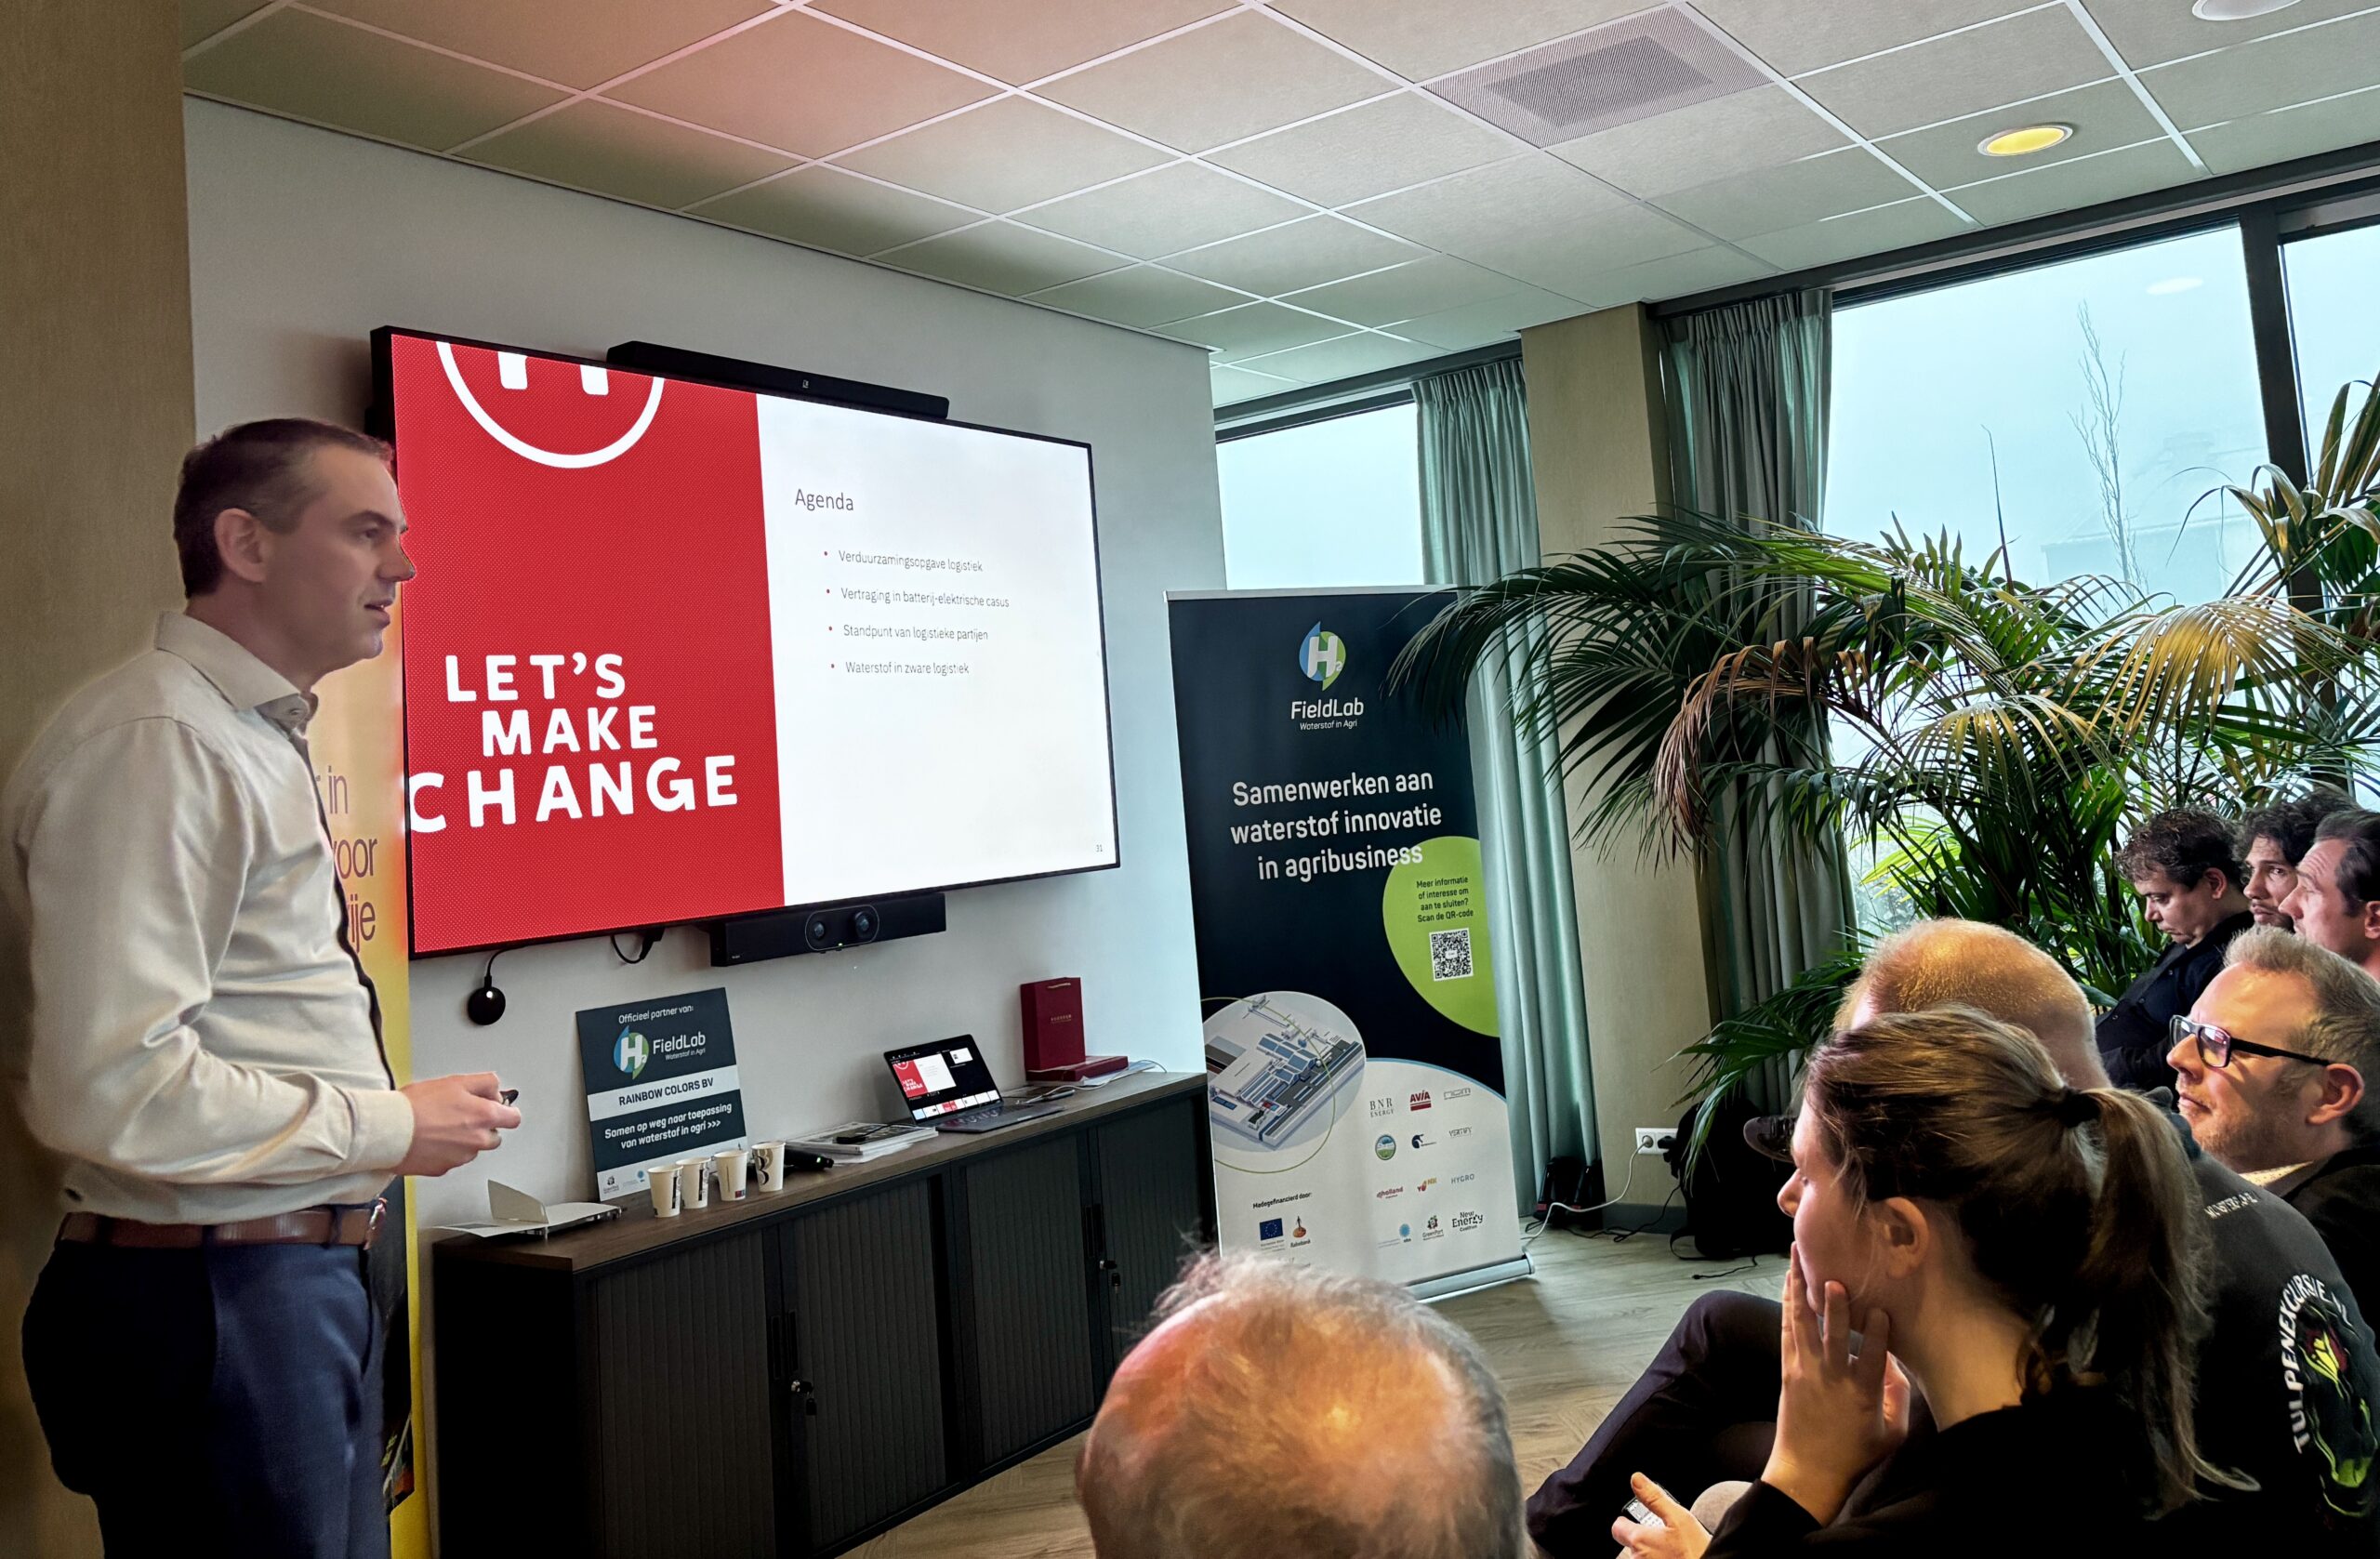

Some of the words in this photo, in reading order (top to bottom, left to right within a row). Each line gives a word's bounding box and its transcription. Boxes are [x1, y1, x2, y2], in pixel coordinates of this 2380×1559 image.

[795, 488, 853, 511] Agenda
[839, 549, 945, 571] Verduurzamingsopgave
[947, 559, 983, 573] logistiek
[840, 587, 891, 604] Vertraging
[892, 590, 901, 602] in
[903, 591, 985, 606] batterij-elektrische
[985, 598, 1010, 608] casus
[843, 624, 892, 640] Standpunt
[894, 628, 910, 638] van
[913, 627, 955, 641] logistieke
[957, 628, 988, 642] partijen
[445, 652, 626, 702] LET'S
[845, 661, 892, 674] Waterstof
[893, 662, 903, 673] in
[905, 664, 932, 674] zware
[933, 662, 970, 677] logistiek
[1290, 697, 1364, 720] FieldLab
[482, 705, 657, 757] MAKE
[1300, 720, 1335, 731] Waterstof
[1336, 720, 1342, 729] in
[1343, 720, 1357, 730] Agri
[328, 765, 348, 814] in
[409, 755, 737, 833] CHANGE
[1233, 772, 1389, 807] Samenwerken
[1395, 772, 1434, 793] aan
[1230, 811, 1340, 844] waterstof
[1344, 803, 1442, 834] innovatie
[1258, 855, 1278, 880] in
[1285, 845, 1423, 882] agribusiness
[1416, 880, 1434, 889] Meer
[1435, 876, 1468, 887] informatie
[1421, 903, 1433, 911] aan
[1443, 897, 1469, 908] sluiten?
[1426, 890, 1458, 899] interesse
[1417, 914, 1435, 922] Scan
[1446, 909, 1474, 920] QR-code
[618, 1011, 649, 1024] Officieel
[651, 1007, 678, 1021] partner
[679, 1005, 694, 1014] van:
[653, 1031, 706, 1054] FieldLab
[665, 1050, 690, 1061] Waterstof
[695, 1048, 706, 1057] Agri
[619, 1087, 663, 1106] RAINBOW
[664, 1080, 700, 1098] COLORS
[702, 1077, 714, 1090] BV
[1369, 1097, 1393, 1111] BNR
[604, 1124, 635, 1140] Samen
[637, 1123, 648, 1134] op
[649, 1117, 667, 1129] weg
[668, 1113, 687, 1125] naar
[687, 1102, 733, 1121] toepassing
[620, 1138, 637, 1150] van
[638, 1128, 681, 1146] waterstof
[681, 1126, 689, 1136] in
[690, 1121, 707, 1134] agri
[1451, 1173, 1474, 1184] HYGRO
[1452, 1214, 1484, 1228] Energy
[1460, 1210, 1474, 1219] New
